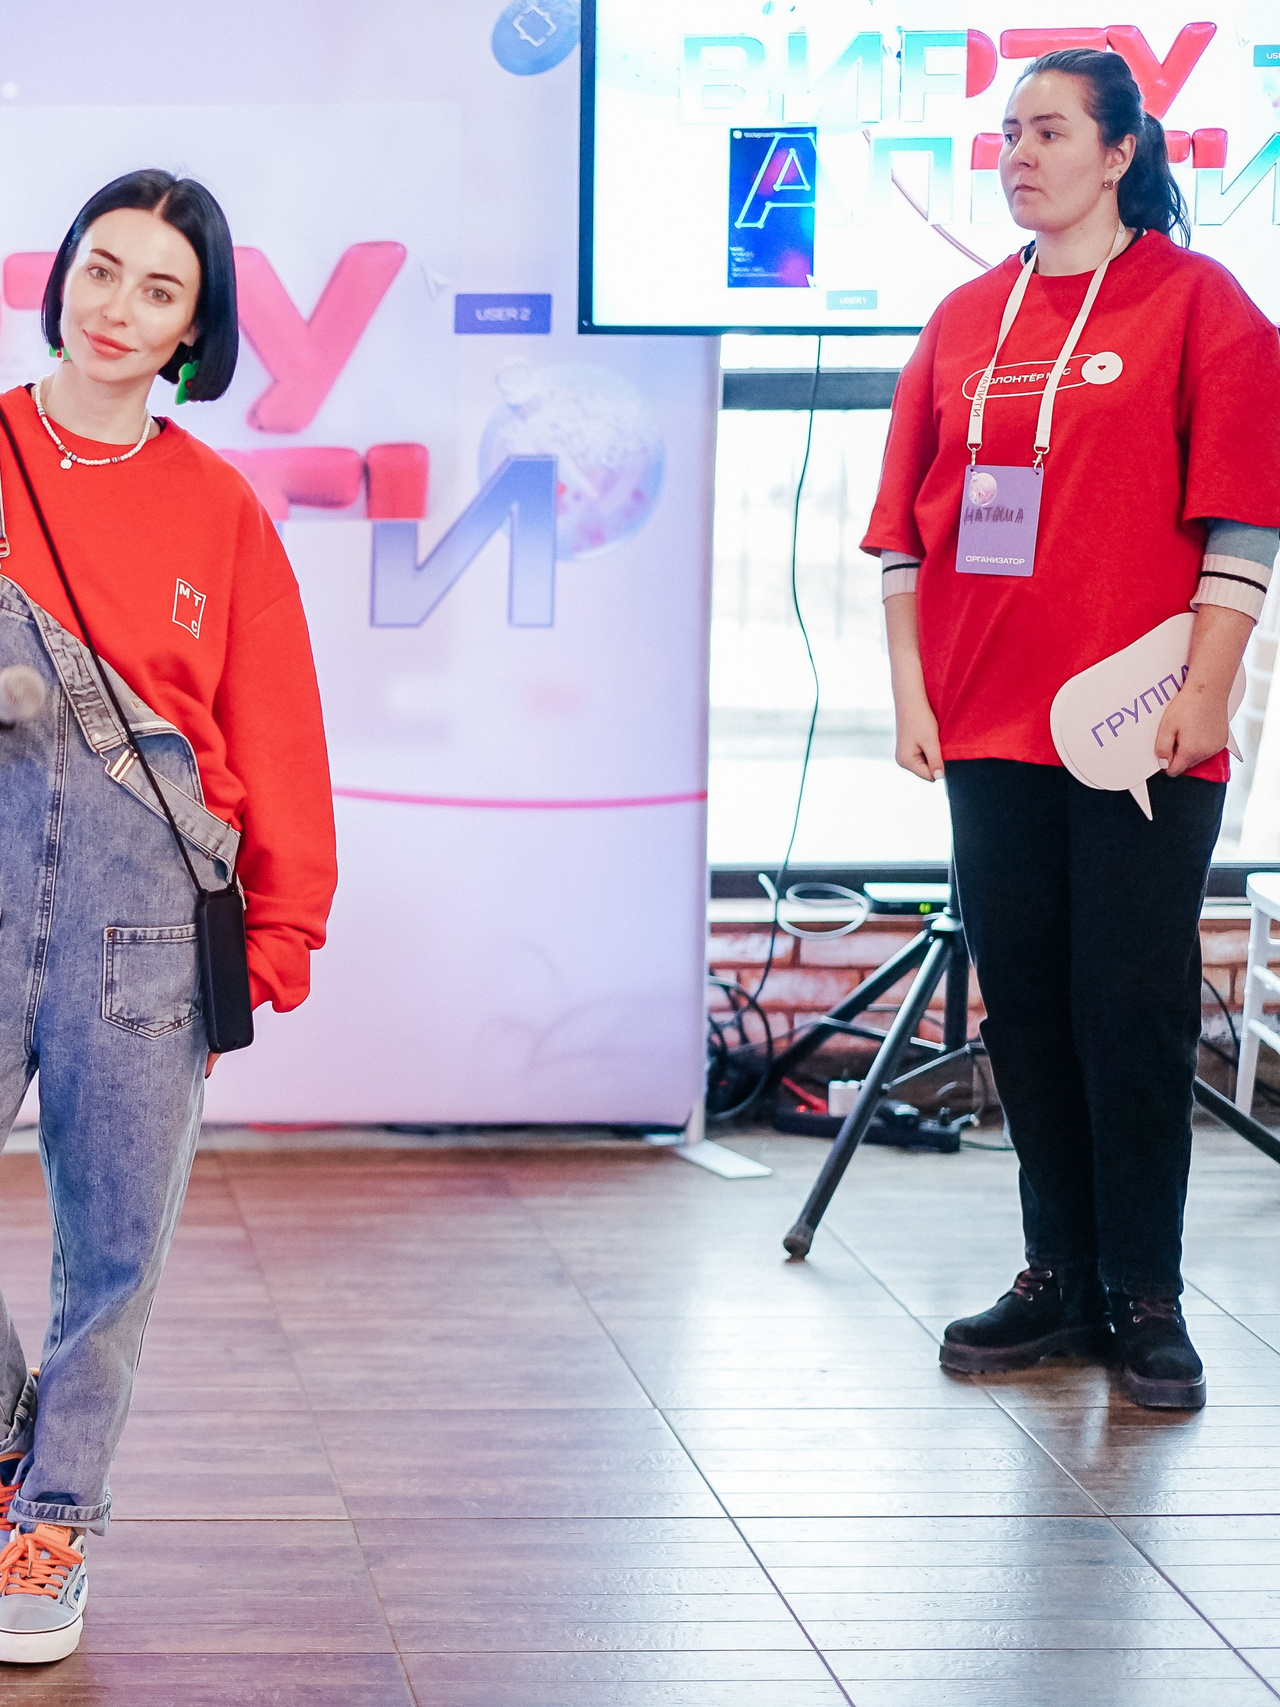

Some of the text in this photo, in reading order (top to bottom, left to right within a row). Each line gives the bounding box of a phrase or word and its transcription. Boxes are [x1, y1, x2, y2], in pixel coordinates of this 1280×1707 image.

[1266, 52, 1280, 60] US
[734, 127, 1280, 227] АЛИ
[475, 307, 519, 321] USER
[988, 367, 1071, 385] ОЛОНТЁР МС
[965, 555, 1026, 566] ОРГАНИЗАТОР
